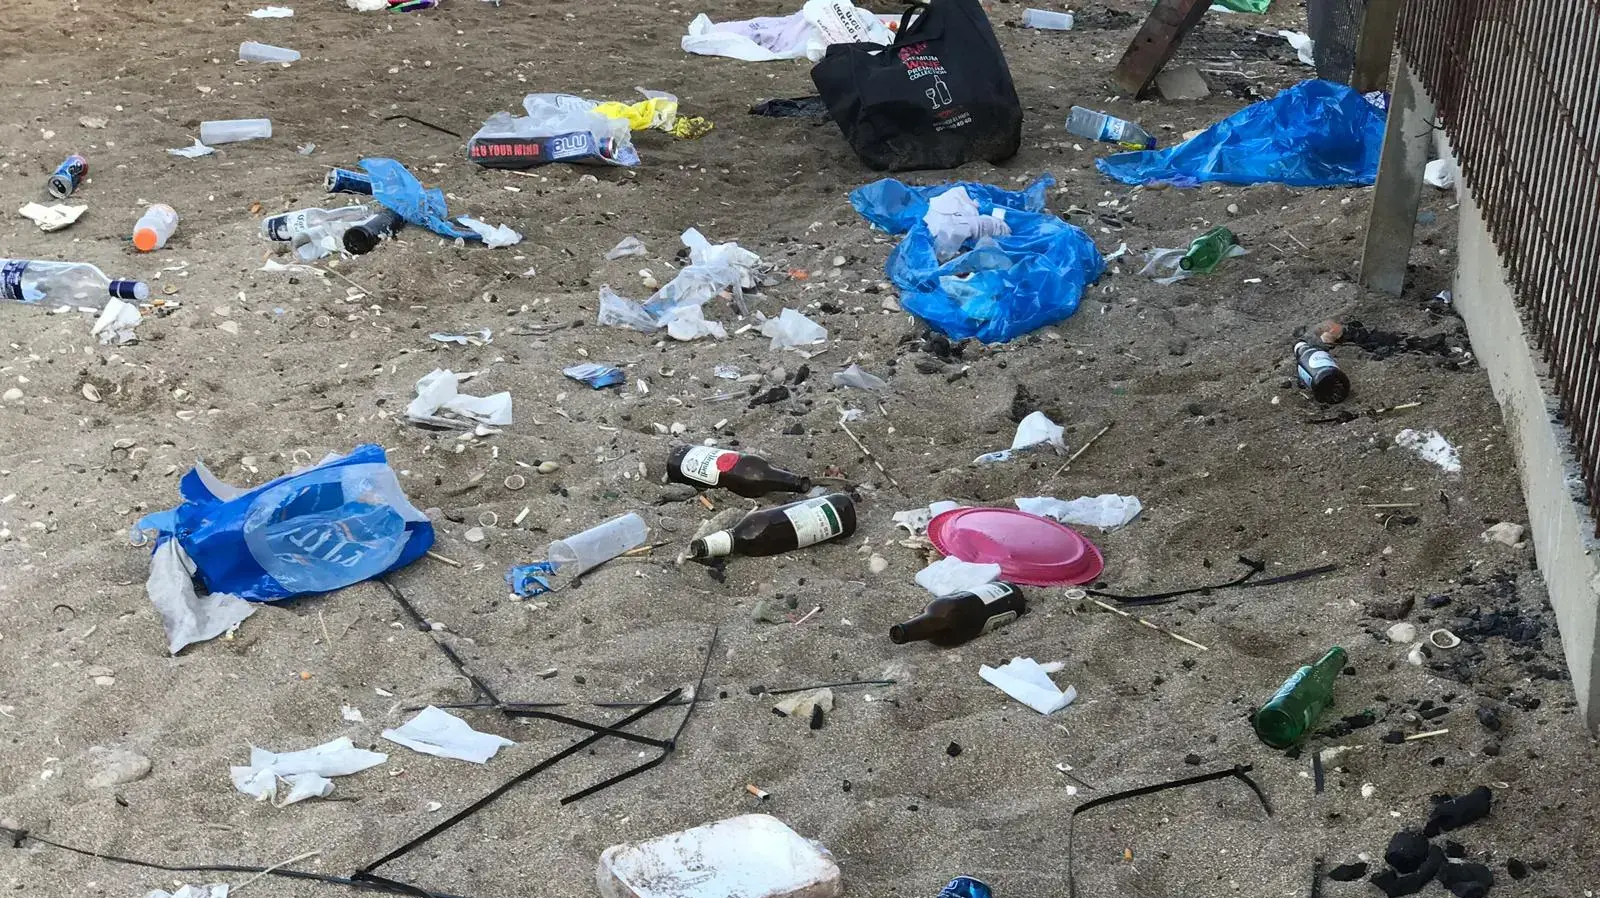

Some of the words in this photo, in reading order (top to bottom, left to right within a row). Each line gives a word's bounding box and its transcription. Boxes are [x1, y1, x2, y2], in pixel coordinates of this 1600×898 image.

[909, 71, 948, 81] COLLECTION
[488, 144, 513, 157] YOUR
[514, 143, 539, 156] MIND
[552, 133, 587, 153] BLU
